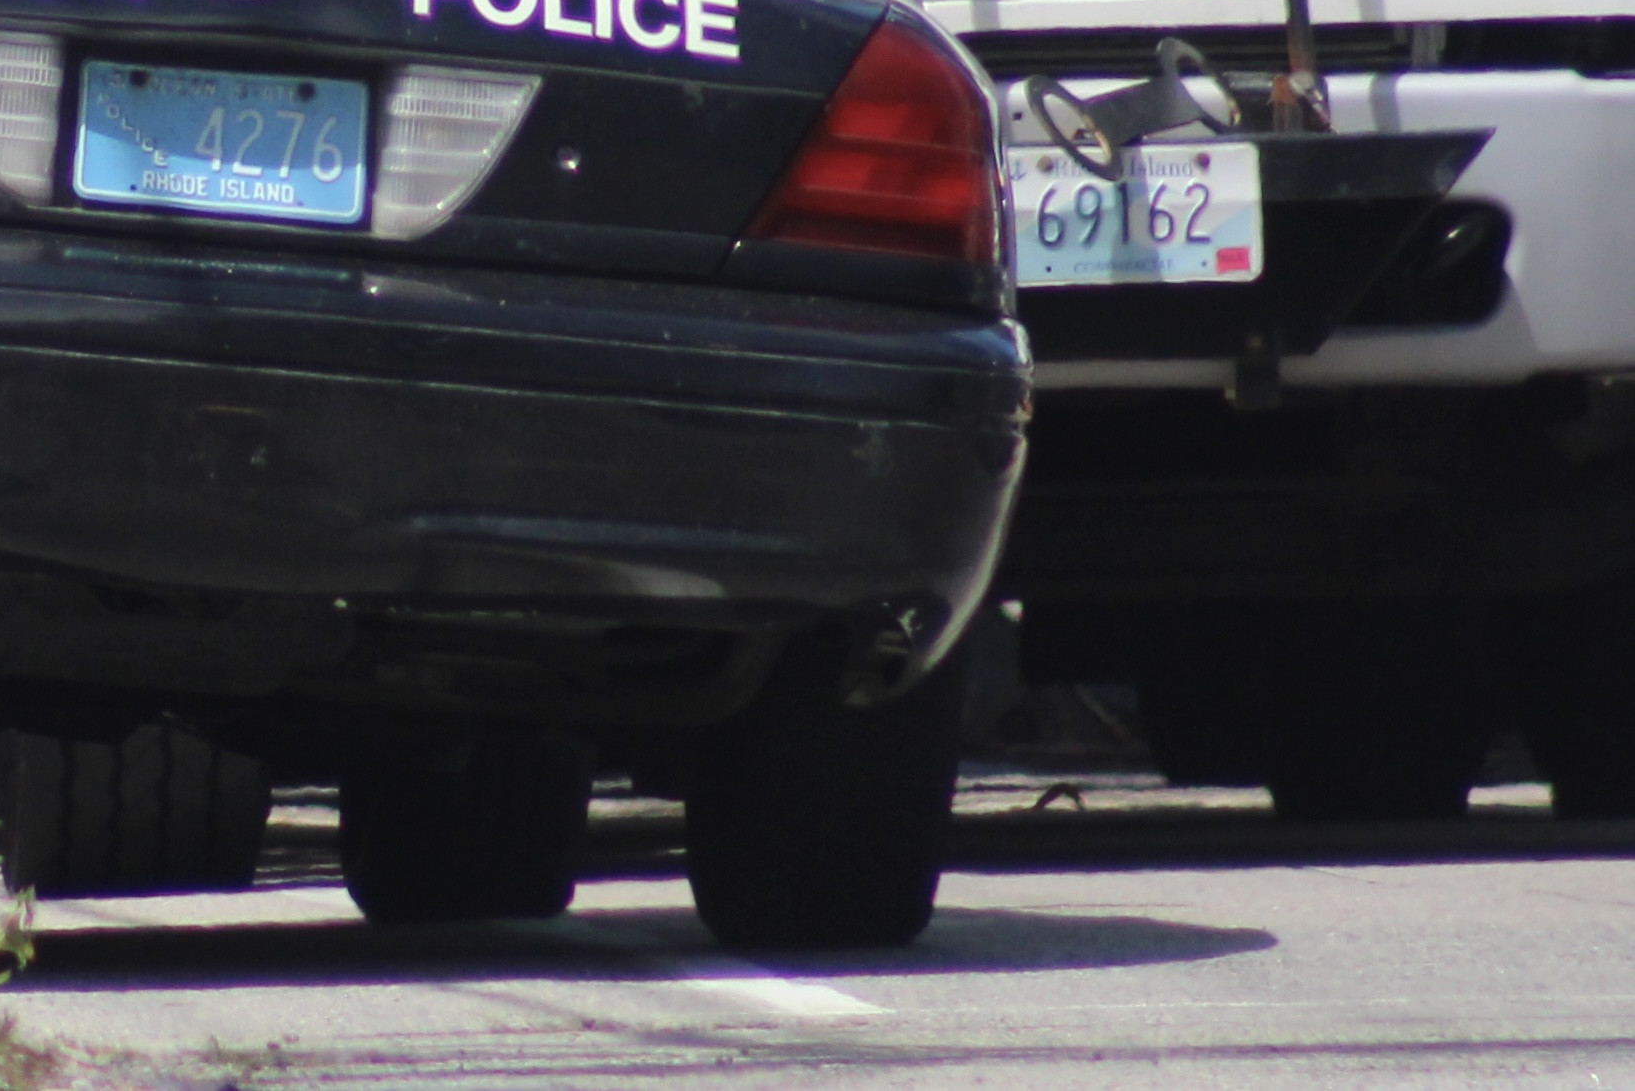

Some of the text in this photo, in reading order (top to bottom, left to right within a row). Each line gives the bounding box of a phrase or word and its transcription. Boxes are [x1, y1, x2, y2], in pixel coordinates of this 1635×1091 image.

[195, 106, 343, 183] 4276
[142, 170, 295, 204] RHODE ISLAND
[1038, 181, 1212, 248] 69162
